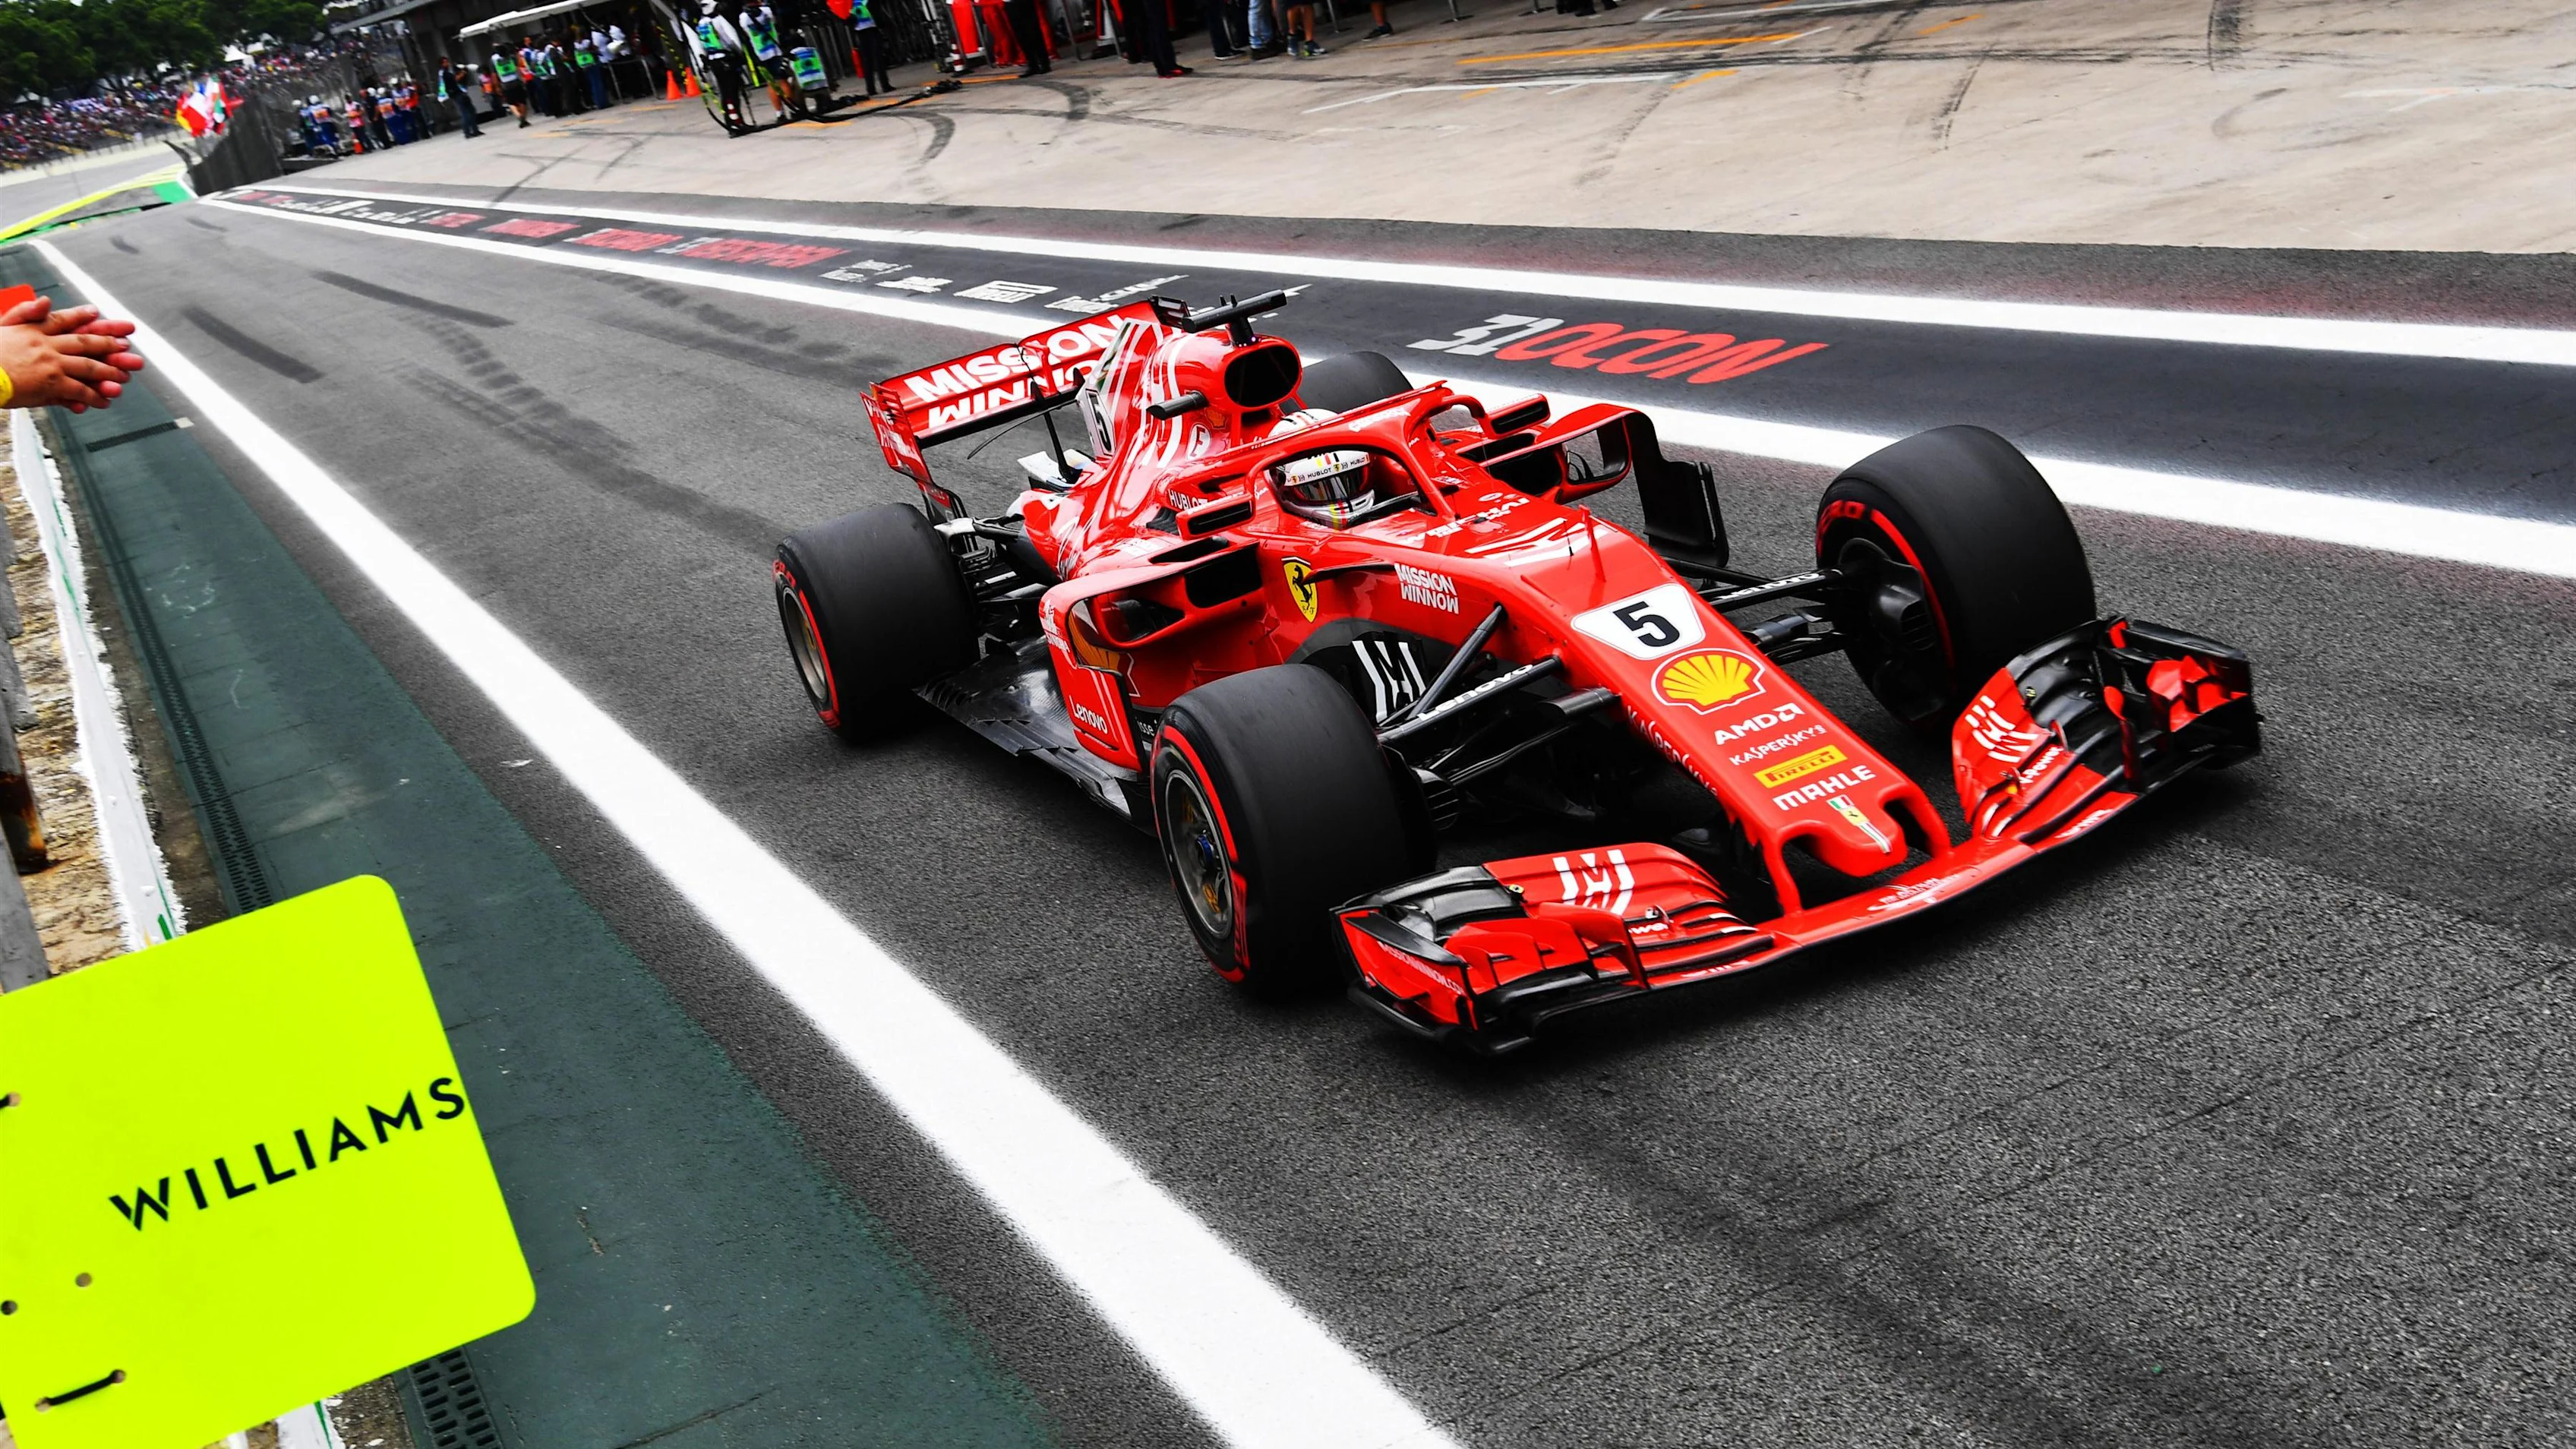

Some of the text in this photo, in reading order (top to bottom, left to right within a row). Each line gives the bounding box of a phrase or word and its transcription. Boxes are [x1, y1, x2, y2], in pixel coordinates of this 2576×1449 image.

[1495, 323, 1829, 384] OCON
[928, 358, 1100, 429] WINNO
[1089, 393, 1112, 451] 5
[1308, 468, 1331, 478] HUBLOT
[1168, 488, 1208, 510] HUBLO
[1394, 563, 1457, 595] MISSION
[1400, 582, 1460, 614] WINNOW
[1613, 601, 1680, 647] 5
[1416, 664, 1533, 721] Lenovo
[1069, 695, 1108, 734] Lenovo
[1714, 714, 1779, 745] AMD
[1729, 727, 1817, 766] KASPERSKY
[1765, 750, 1837, 782] PIRELLI
[1772, 765, 1877, 811] MAHLE
[109, 1077, 465, 1232] WILLIAMS
